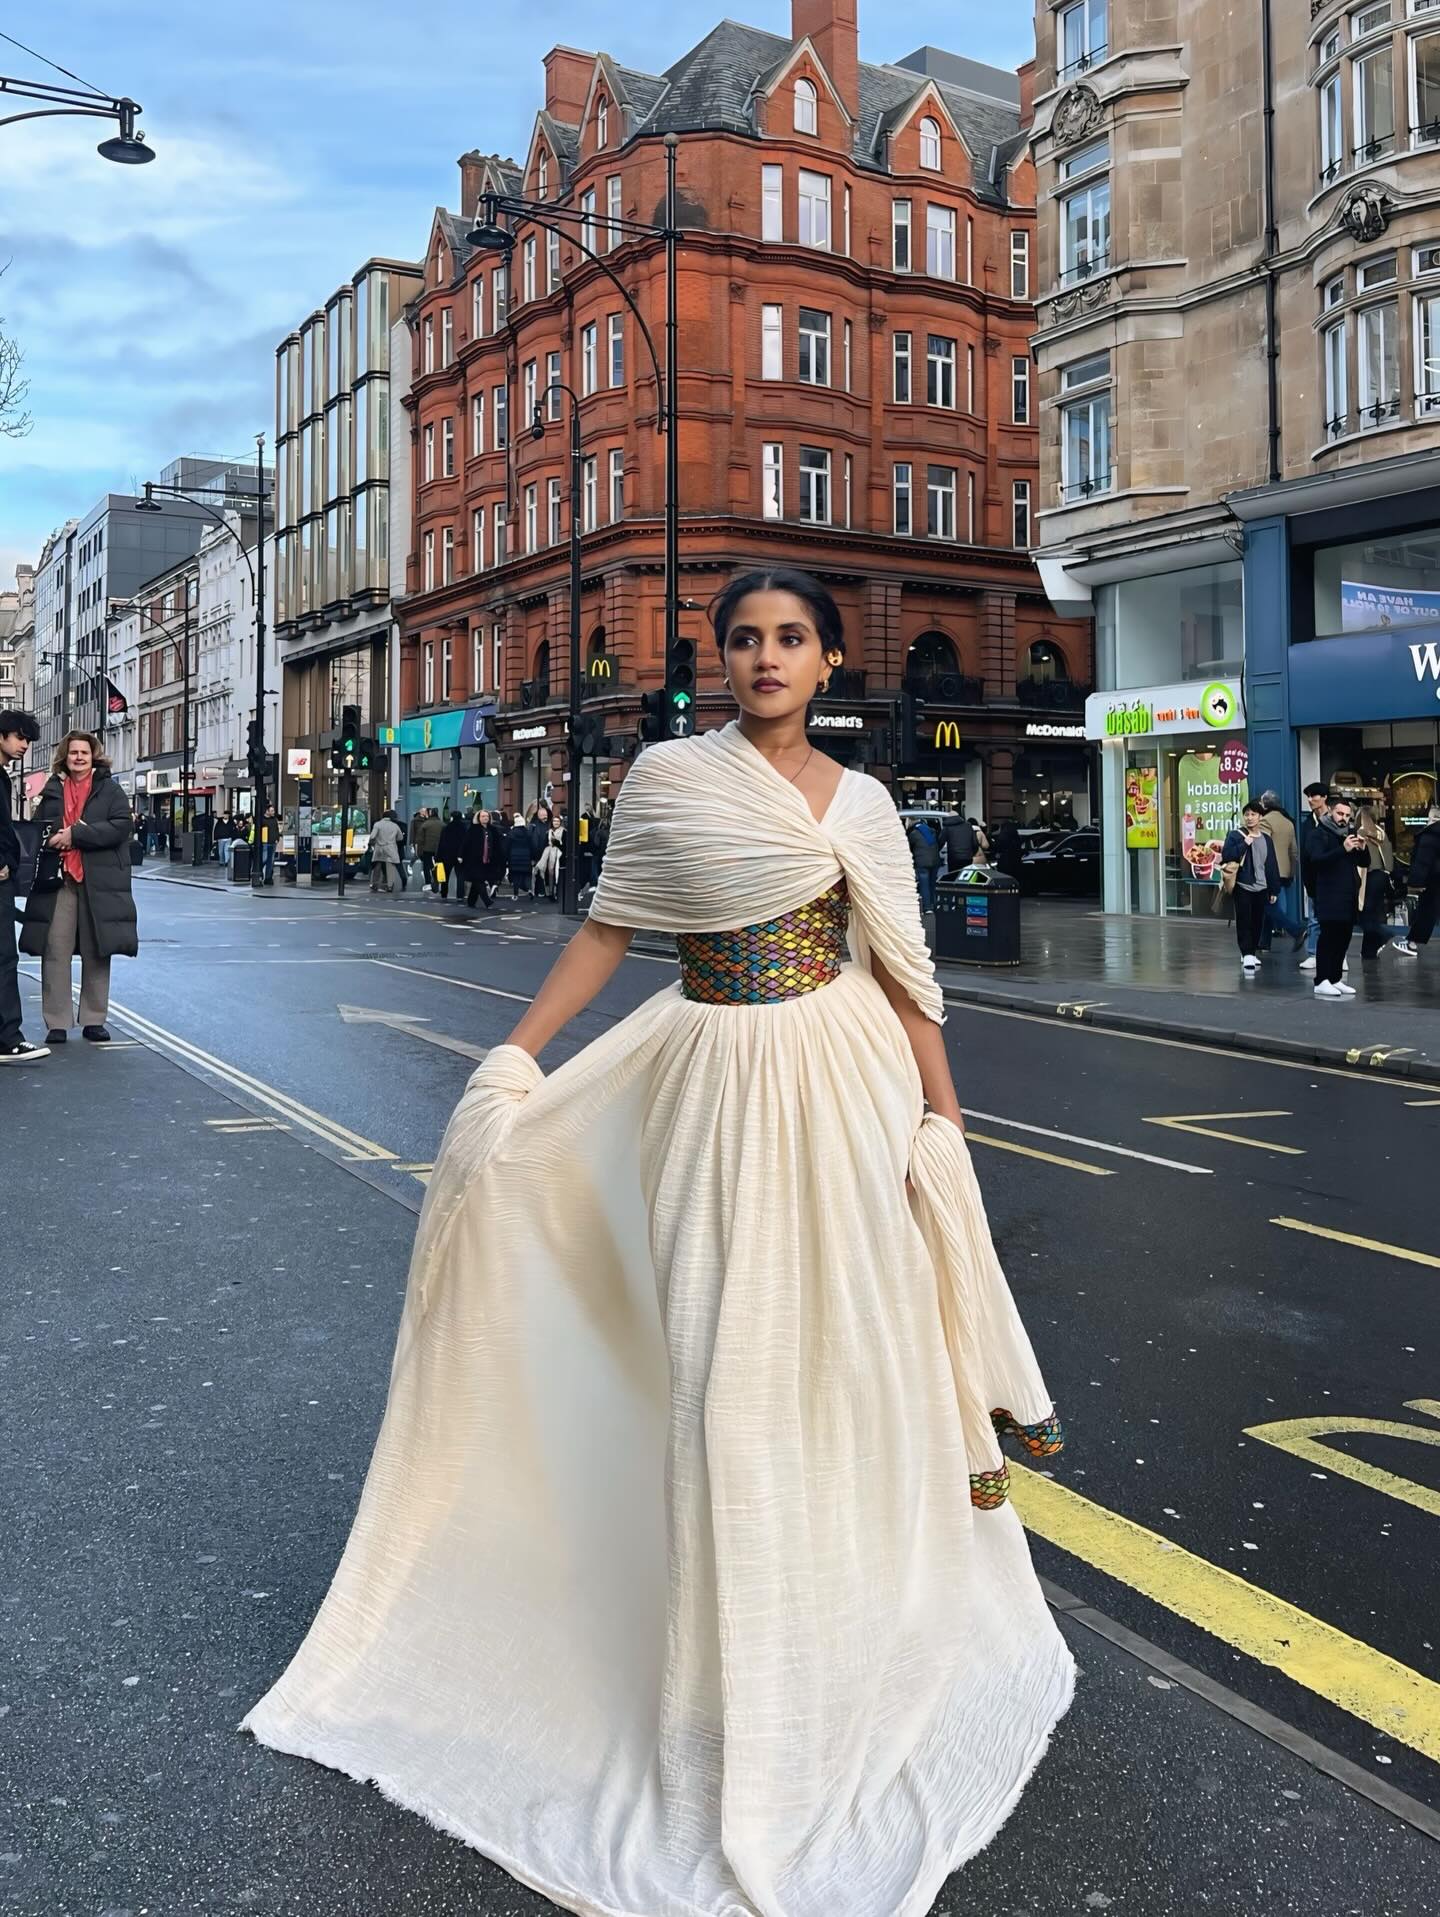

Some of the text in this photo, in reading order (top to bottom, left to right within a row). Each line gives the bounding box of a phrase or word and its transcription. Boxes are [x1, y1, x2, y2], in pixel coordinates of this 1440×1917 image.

[1187, 779, 1241, 797] kobachi
[1202, 796, 1241, 813] snack
[1205, 814, 1241, 831] drink
